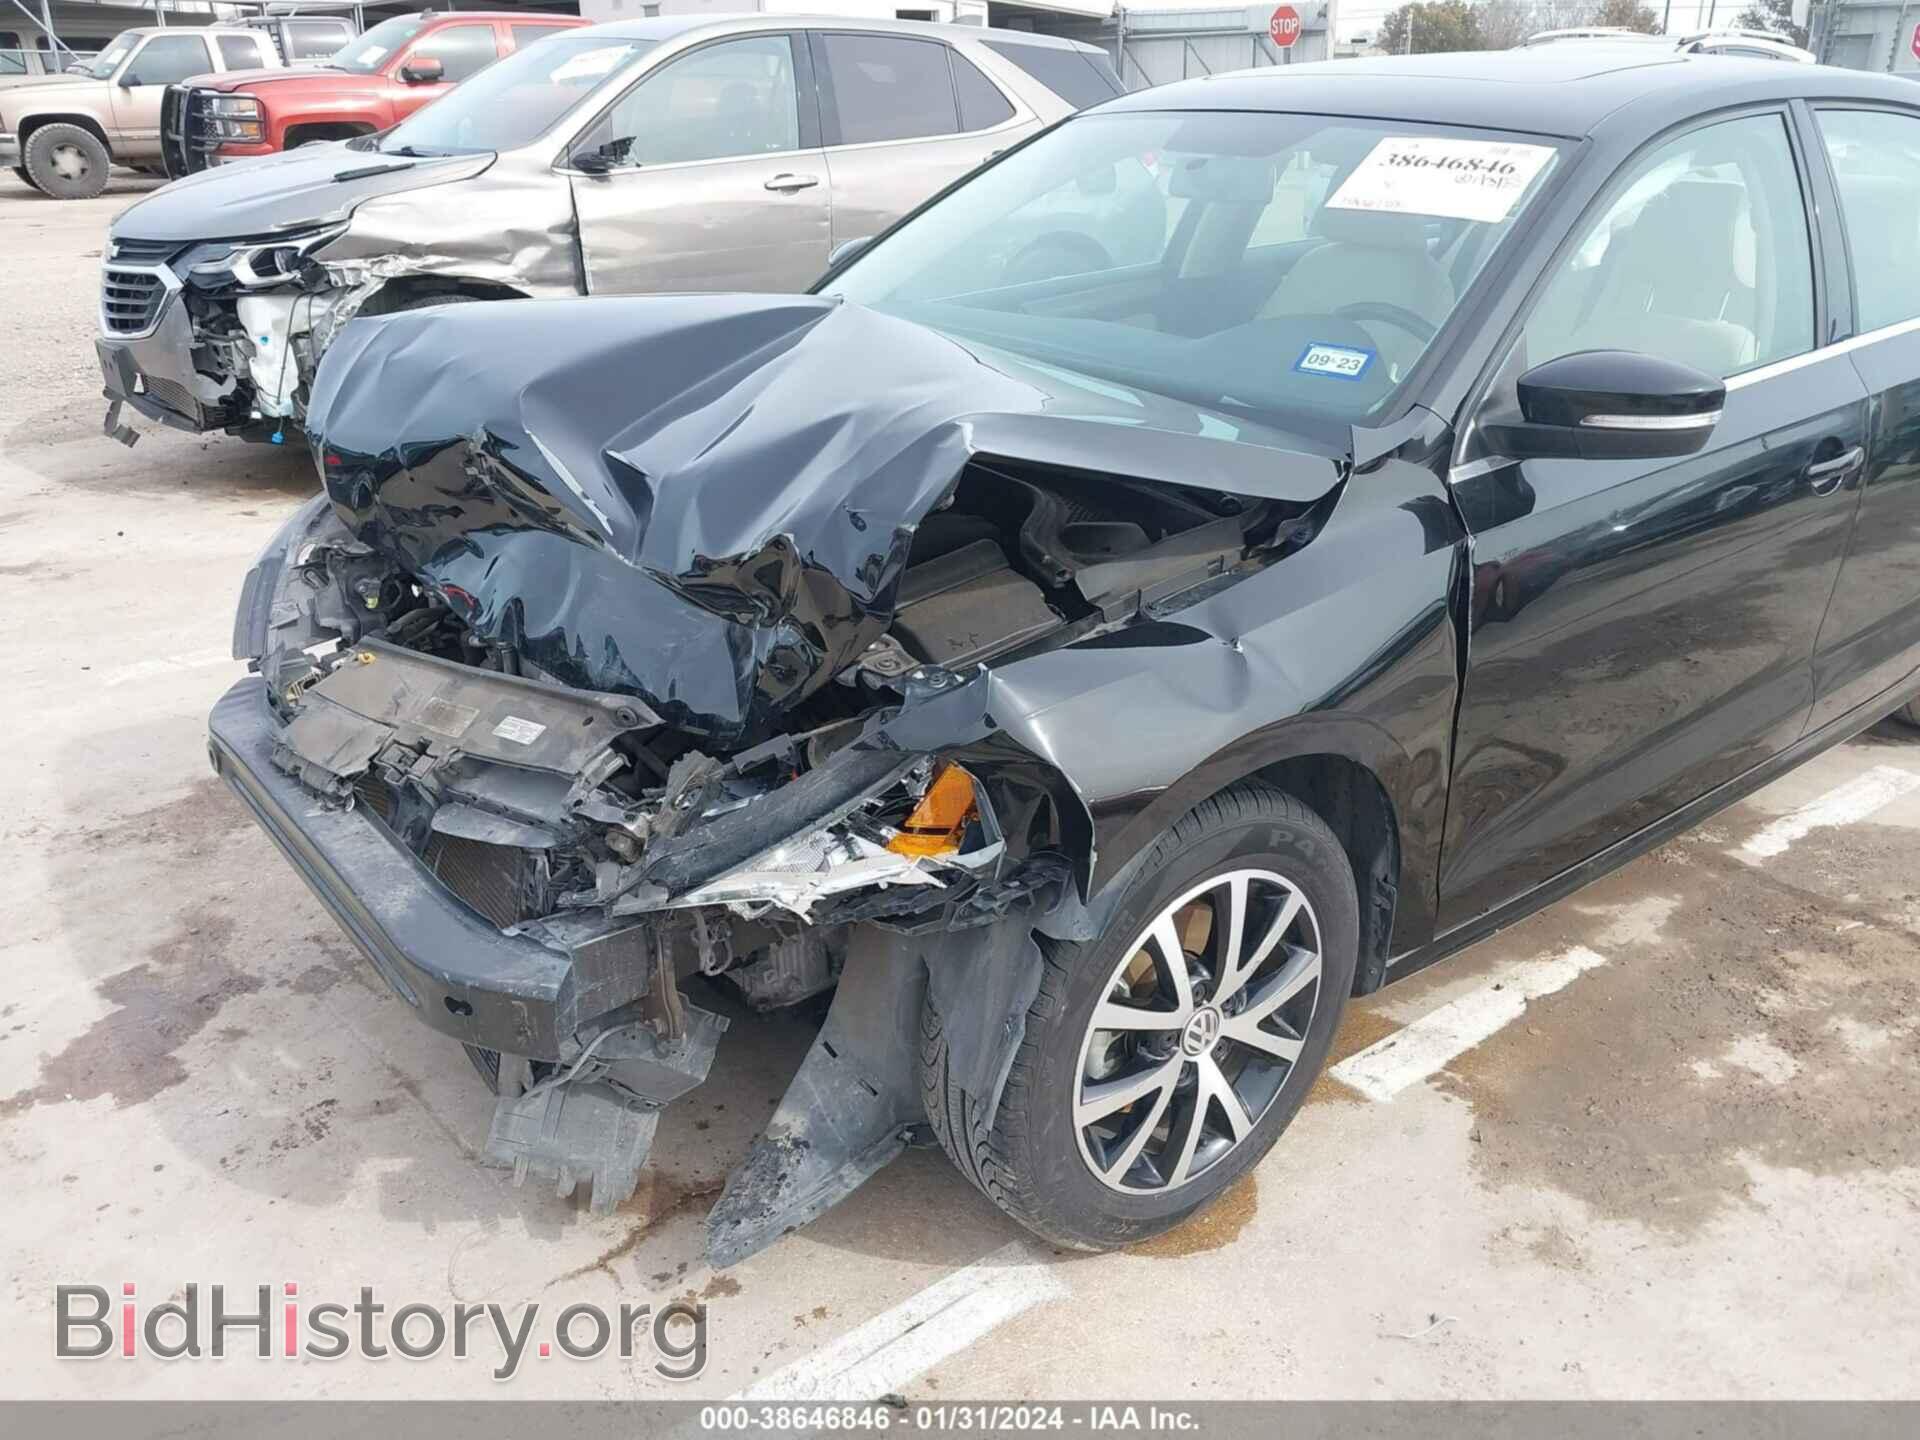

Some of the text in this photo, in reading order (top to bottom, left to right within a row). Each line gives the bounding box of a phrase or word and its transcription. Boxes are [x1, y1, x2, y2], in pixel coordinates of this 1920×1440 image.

[1271, 17, 1298, 35] STOP
[1379, 153, 1515, 174] 38646846
[1307, 353, 1361, 370] 09 23
